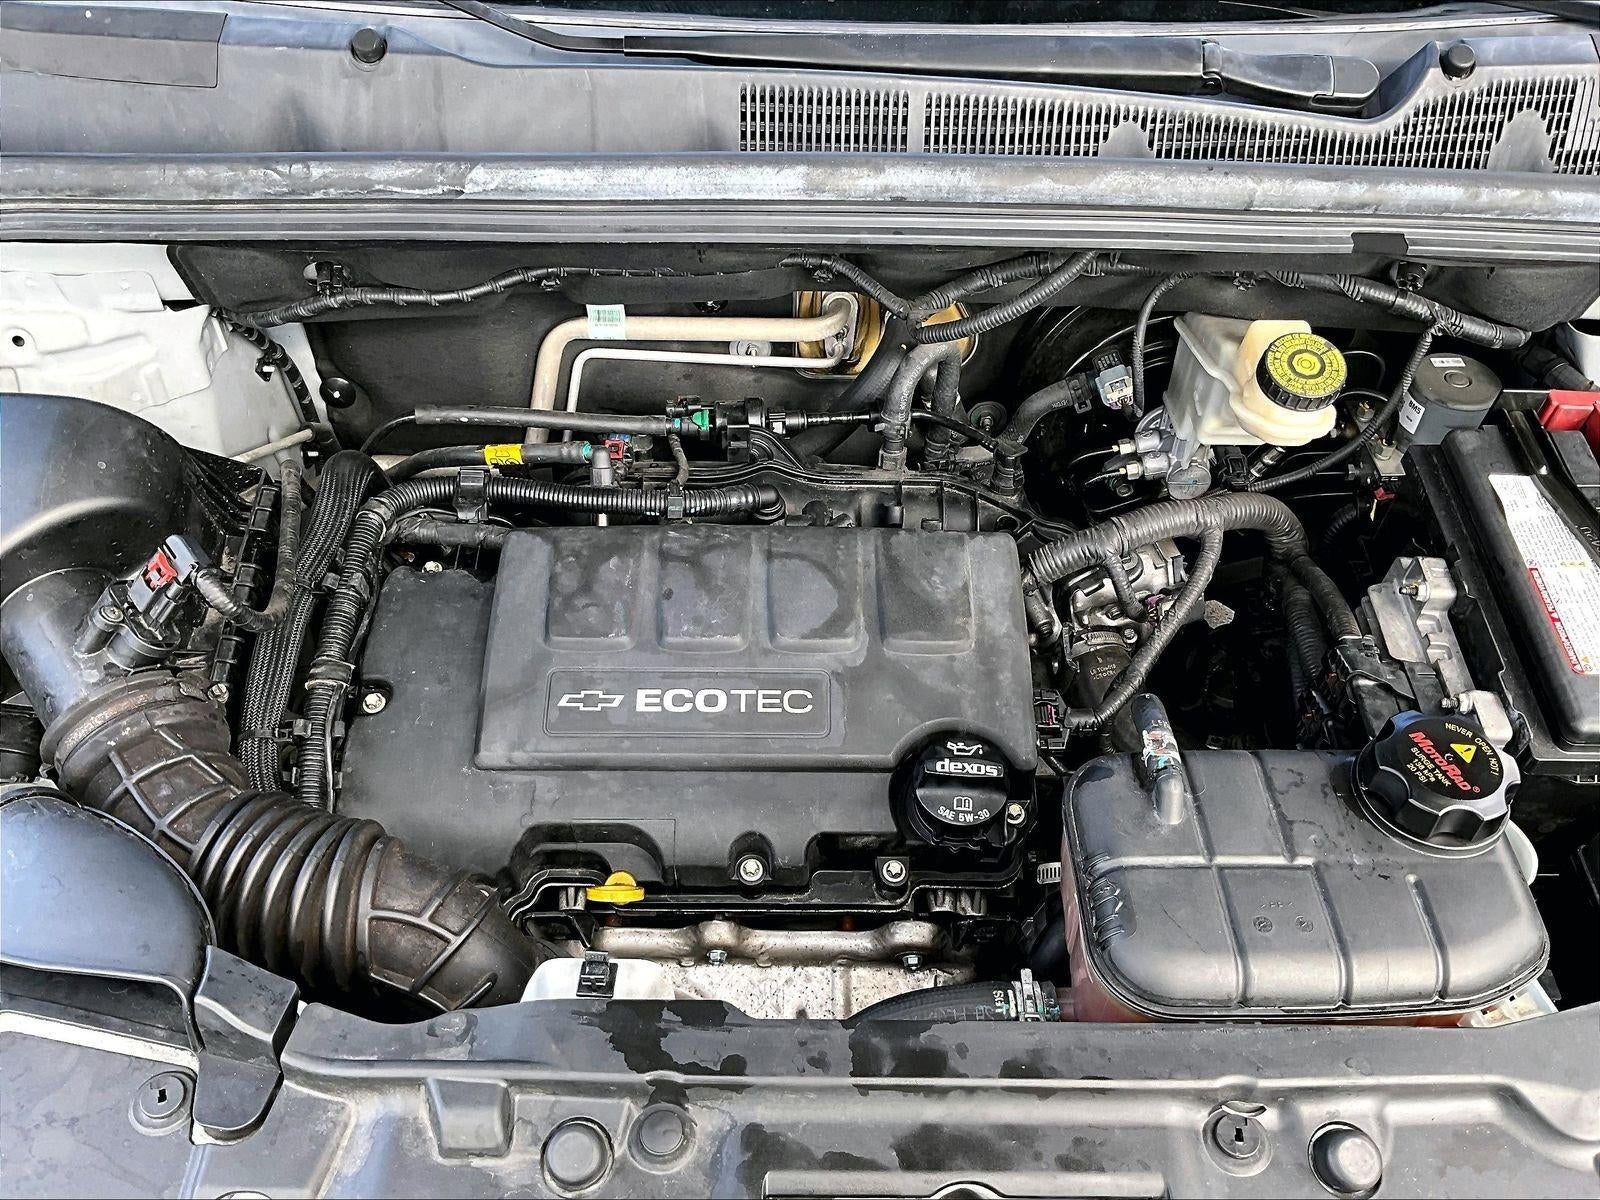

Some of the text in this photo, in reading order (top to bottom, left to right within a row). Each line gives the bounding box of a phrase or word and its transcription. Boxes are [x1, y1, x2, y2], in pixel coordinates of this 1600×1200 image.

[635, 688, 813, 714] ECOTEC
[1445, 723, 1499, 776] NEVER OPEN HOT!
[935, 758, 998, 777] dexos
[1407, 763, 1428, 783] 20 PSI
[1411, 747, 1451, 787] SURGE TANK
[937, 805, 990, 823] SAE 5W-30
